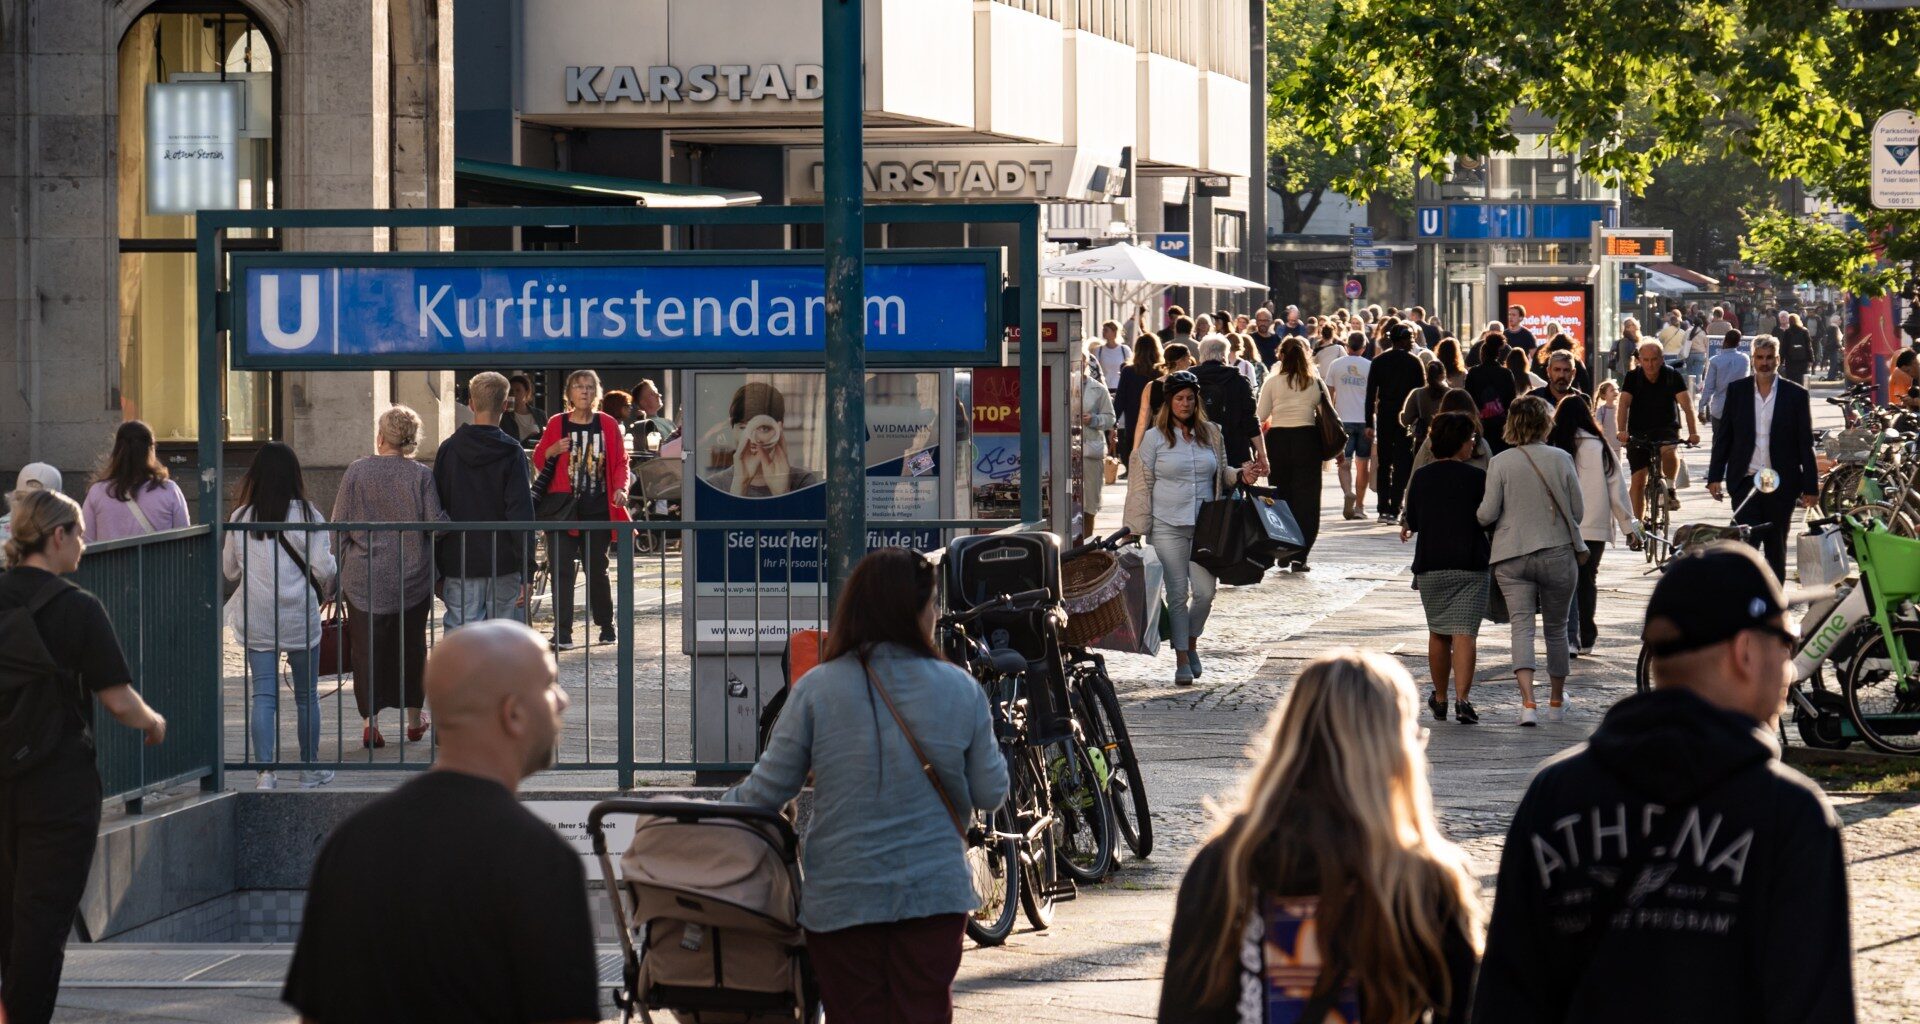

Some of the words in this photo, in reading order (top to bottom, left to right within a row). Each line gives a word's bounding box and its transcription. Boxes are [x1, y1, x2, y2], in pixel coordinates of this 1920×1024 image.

[565, 64, 824, 104] KARSTAD
[1423, 209, 1438, 234] U
[260, 274, 320, 350] U
[728, 531, 755, 548] Sie
[763, 558, 776, 568] Ihr
